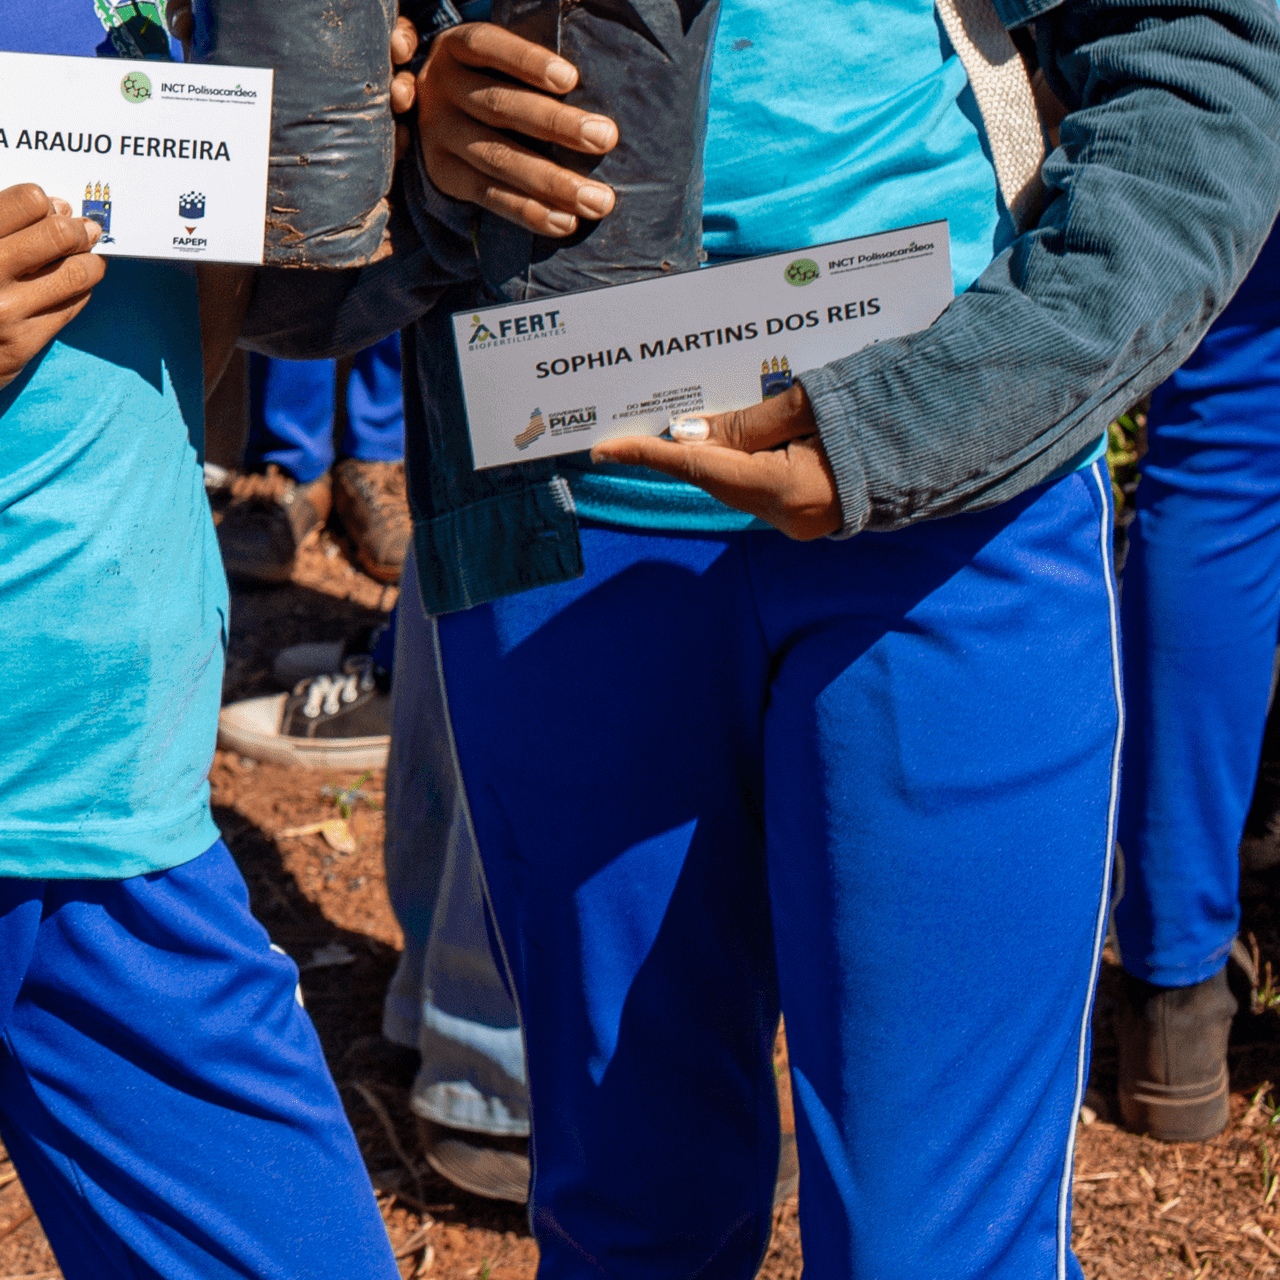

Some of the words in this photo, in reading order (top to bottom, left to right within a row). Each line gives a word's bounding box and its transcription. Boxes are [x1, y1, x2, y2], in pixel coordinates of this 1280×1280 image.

[161, 82, 185, 93] INCT
[15, 129, 113, 155] ARAUJO
[120, 135, 231, 162] FERREIRA
[172, 236, 207, 247] FAPEPI
[468, 327, 567, 352] BIOFERTILIZANTES
[535, 346, 633, 379] SOPHIA
[639, 322, 759, 360] MARTINS
[765, 309, 820, 336] DOS
[826, 297, 881, 324] REIS
